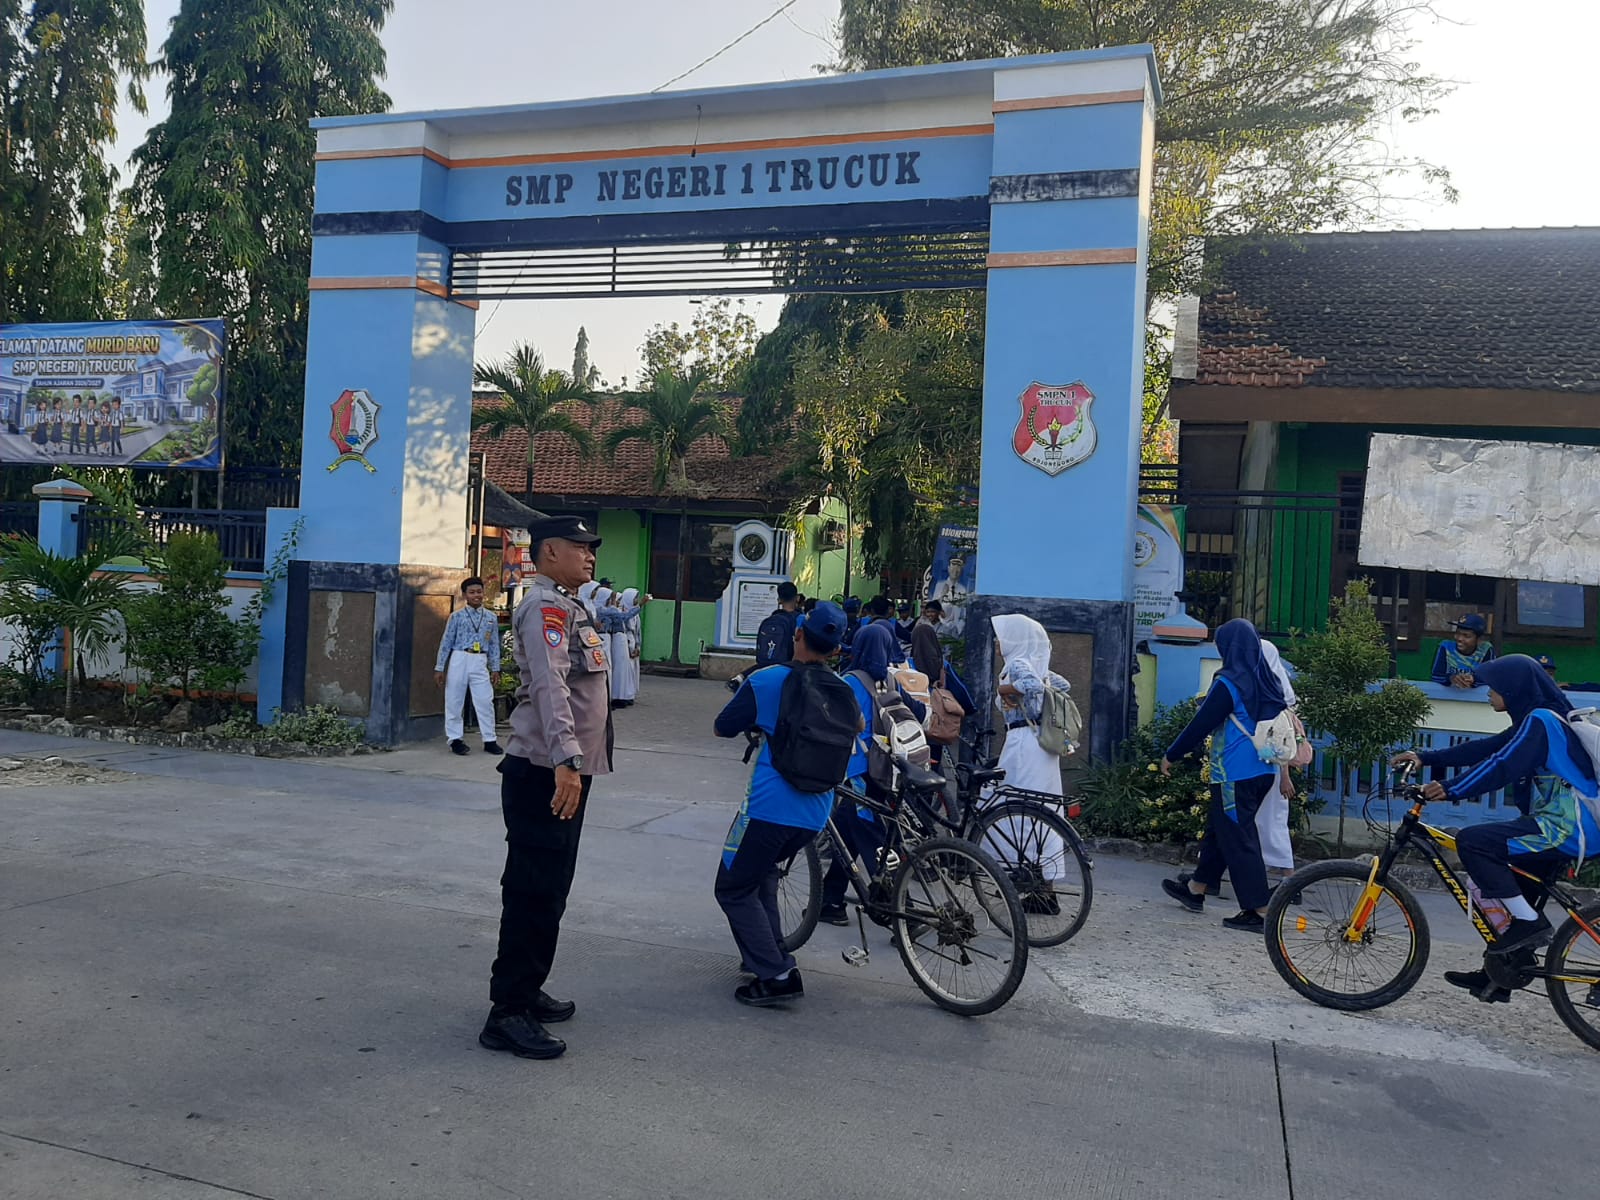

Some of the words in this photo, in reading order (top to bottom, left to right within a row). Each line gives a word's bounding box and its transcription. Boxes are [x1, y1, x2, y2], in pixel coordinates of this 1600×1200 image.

[506, 173, 573, 206] SMP
[597, 164, 727, 202] NEGERI
[741, 163, 754, 194] 1
[766, 151, 920, 193] TRUCUK
[0, 338, 37, 354] LAMAT
[39, 338, 84, 354] DATANG
[86, 337, 124, 353] MURID
[126, 335, 159, 353] BARU
[13, 360, 37, 373] SMP
[38, 360, 79, 373] NEGERI
[81, 360, 87, 373] 1
[89, 359, 137, 373] TRUCUK
[1037, 391, 1067, 399] SMPN
[1137, 611, 1165, 619] UMUM
[1432, 858, 1451, 878] NEW
